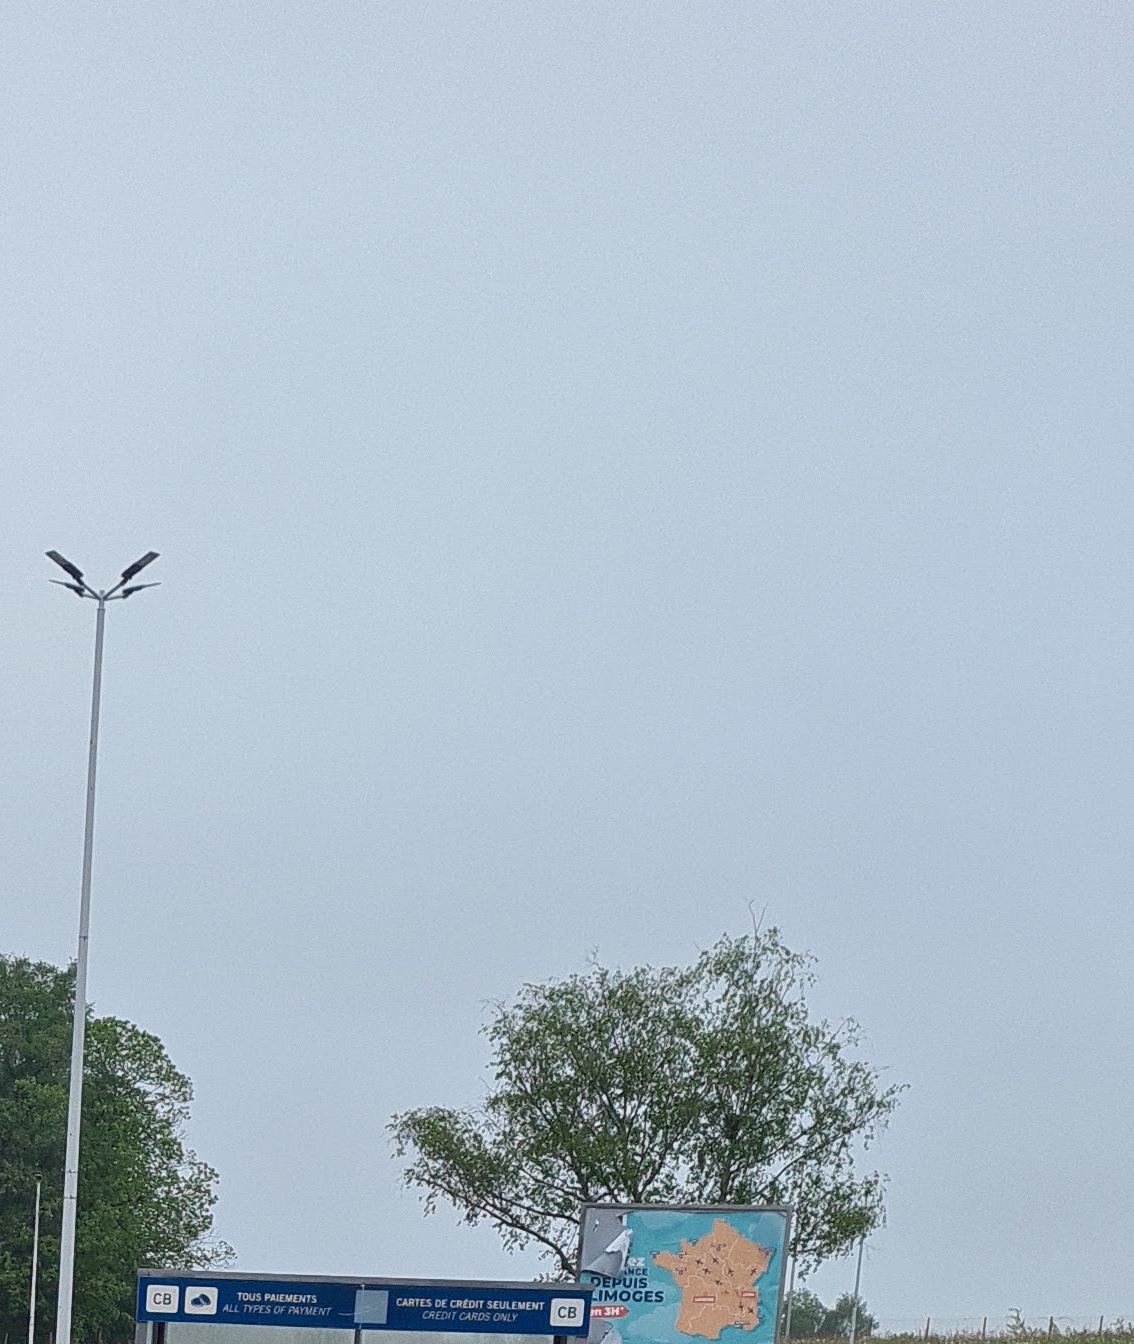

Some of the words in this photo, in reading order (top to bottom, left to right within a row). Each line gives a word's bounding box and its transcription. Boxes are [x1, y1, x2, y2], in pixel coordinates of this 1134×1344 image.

[590, 1276, 648, 1289] DEPUIS
[152, 1292, 172, 1306] CB
[237, 1292, 262, 1302] TOUS
[264, 1293, 317, 1304] PAIEMENTS
[396, 1298, 432, 1308] CARTES
[435, 1299, 448, 1309] DE
[450, 1298, 485, 1309] CRÉDIT
[486, 1300, 545, 1311] SEULEMENT
[222, 1303, 240, 1313] ALL
[243, 1304, 271, 1314] TYPES
[273, 1305, 286, 1315] OF
[288, 1305, 333, 1316] PAYMENT
[557, 1306, 577, 1319] CB
[422, 1310, 456, 1321] CREDIT
[458, 1311, 491, 1322] CARDS
[493, 1312, 519, 1323] ONLY
